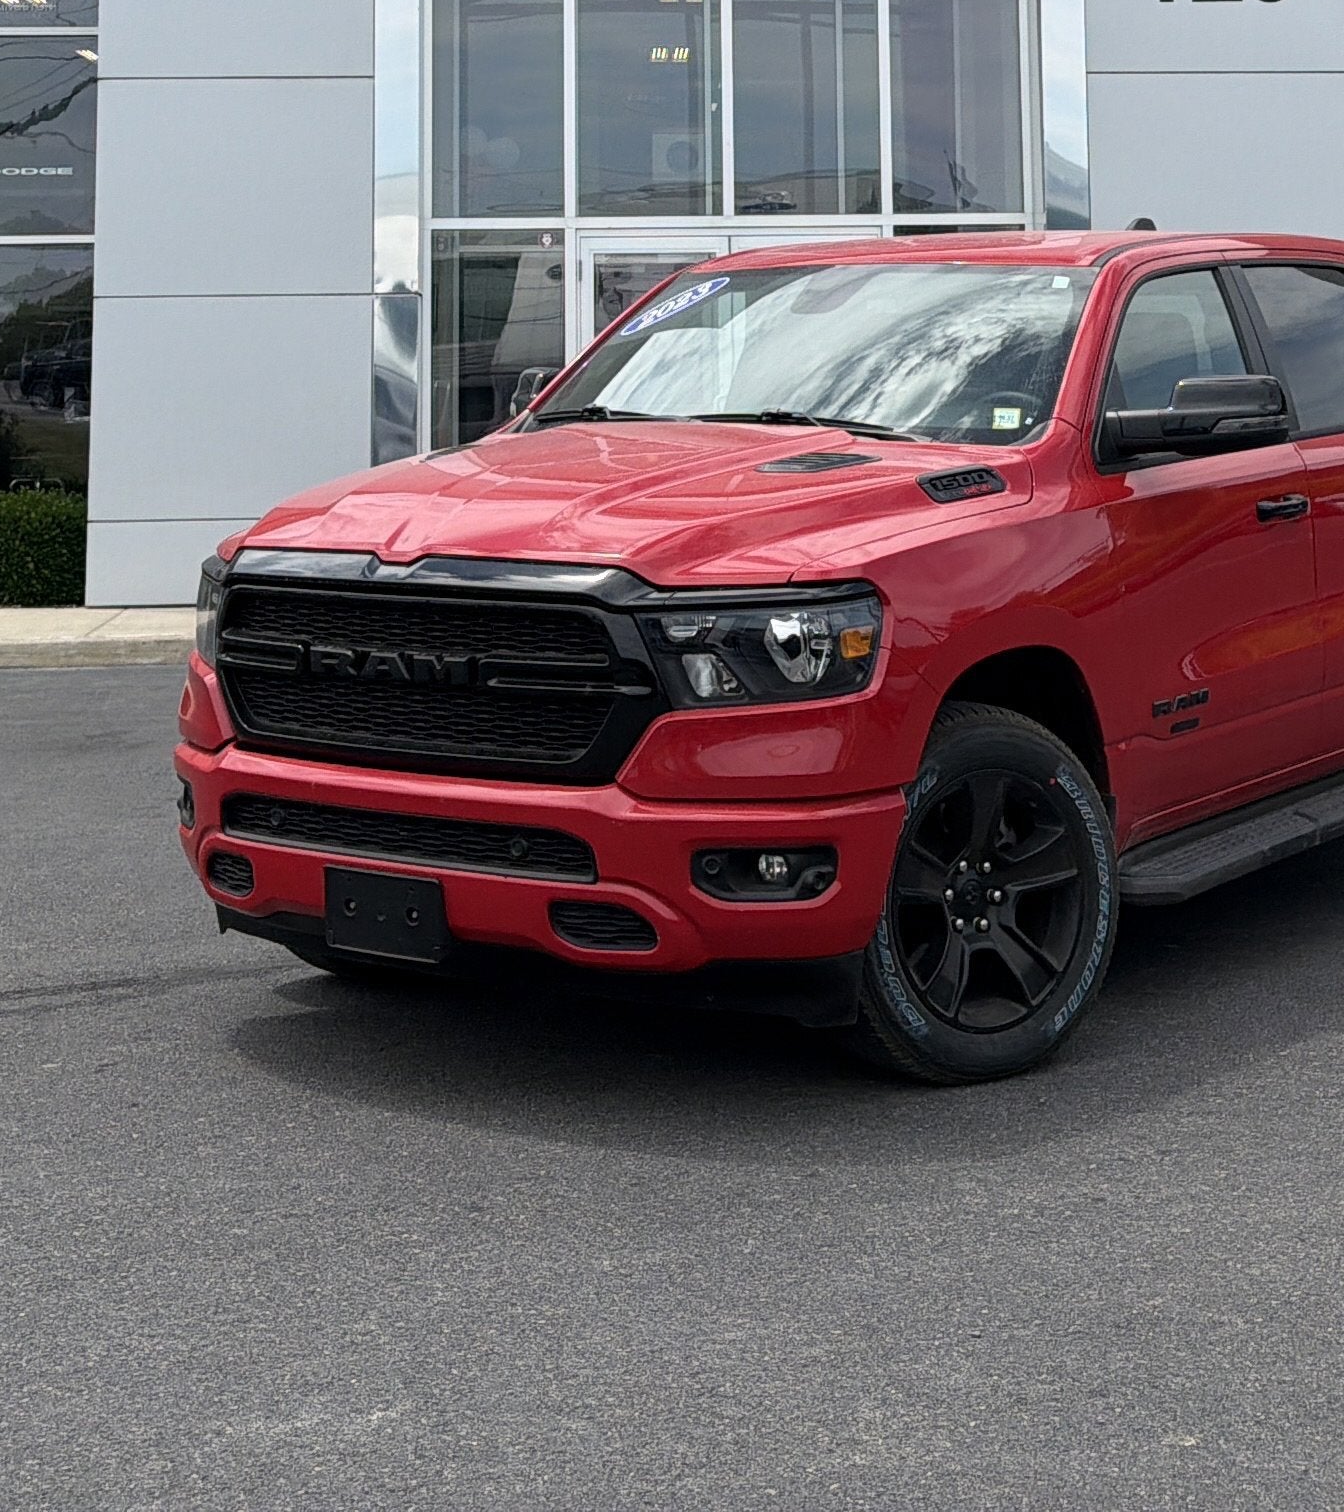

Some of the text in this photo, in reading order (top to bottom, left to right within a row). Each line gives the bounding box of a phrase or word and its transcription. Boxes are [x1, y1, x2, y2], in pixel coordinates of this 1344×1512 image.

[930, 471, 990, 491] 1500
[309, 645, 471, 685] RAM
[875, 893, 927, 1028] DUEL
